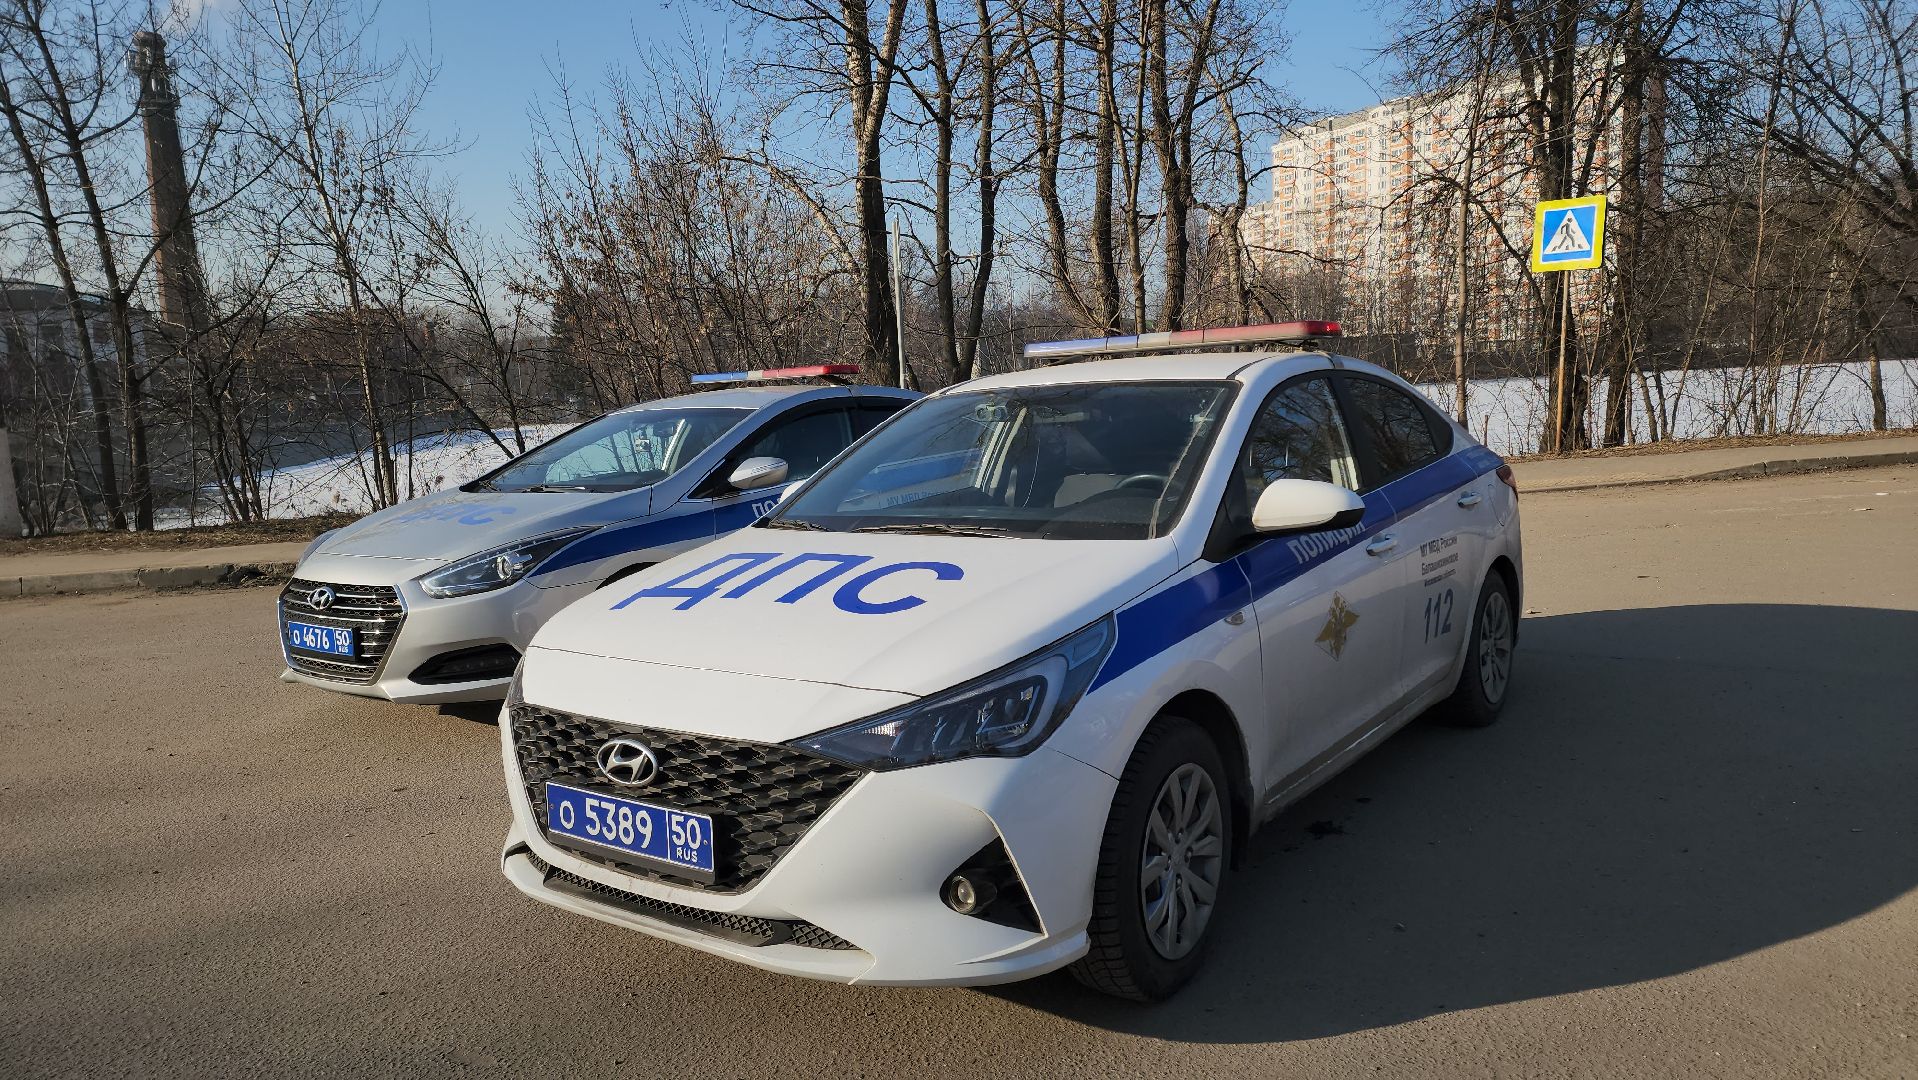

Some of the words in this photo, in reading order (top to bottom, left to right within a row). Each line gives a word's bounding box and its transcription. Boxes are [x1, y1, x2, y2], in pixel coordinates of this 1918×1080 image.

[751, 497, 781, 518] ПО
[608, 552, 965, 615] ДПС
[1424, 588, 1454, 644] 112
[303, 626, 330, 650] 4676
[335, 630, 350, 647] 50
[585, 797, 653, 849] 5389
[671, 814, 701, 850] 50
[676, 847, 698, 863] RUS
